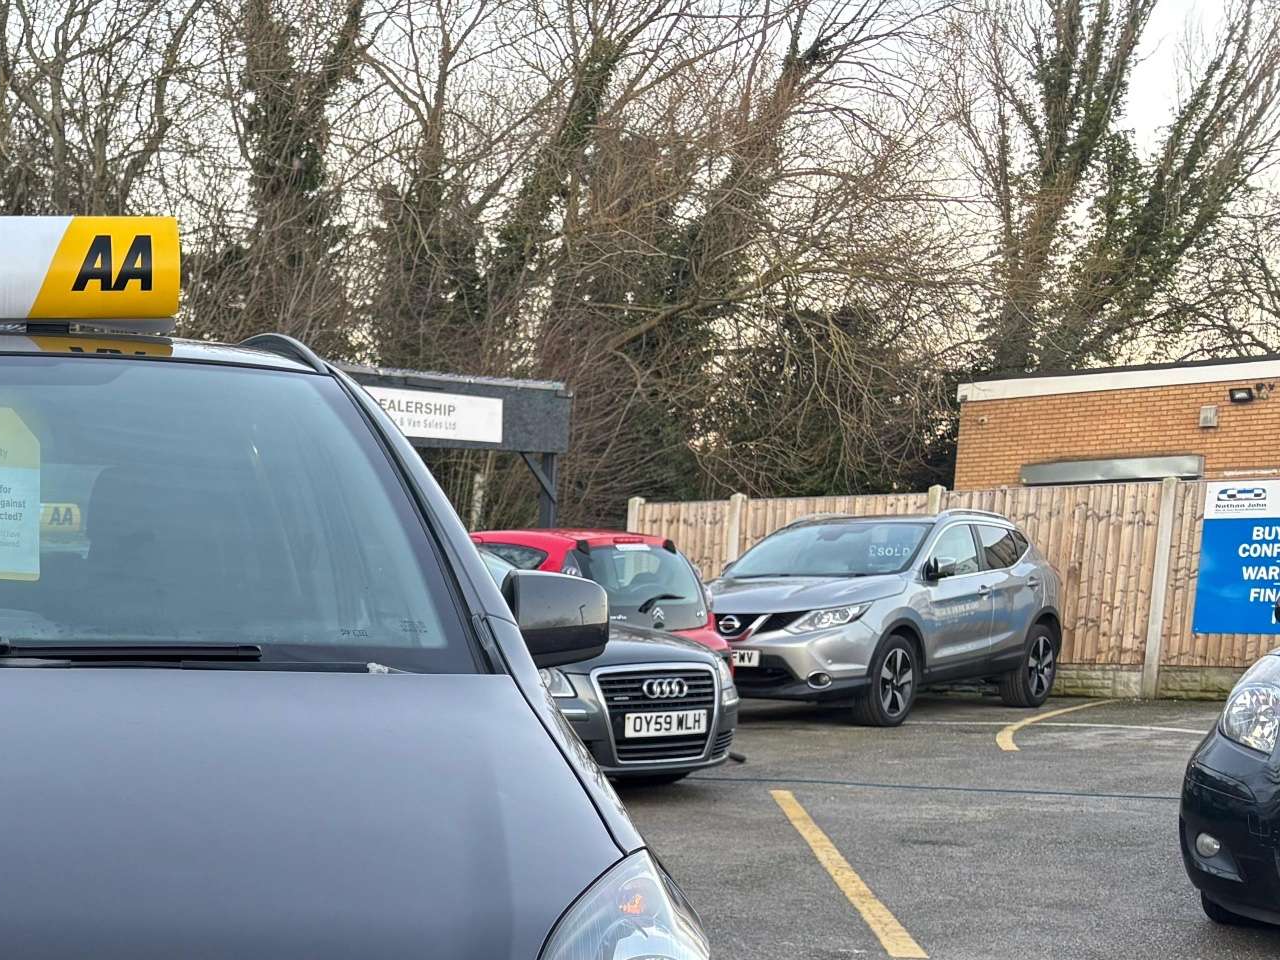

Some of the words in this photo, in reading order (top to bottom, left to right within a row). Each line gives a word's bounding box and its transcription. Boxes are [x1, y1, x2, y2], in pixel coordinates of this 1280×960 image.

[71, 235, 153, 291] AA
[0, 484, 12, 494] for
[48, 507, 73, 526] AA
[1249, 588, 1280, 602] FIN
[633, 714, 672, 732] OY59
[676, 713, 701, 731] WLH
